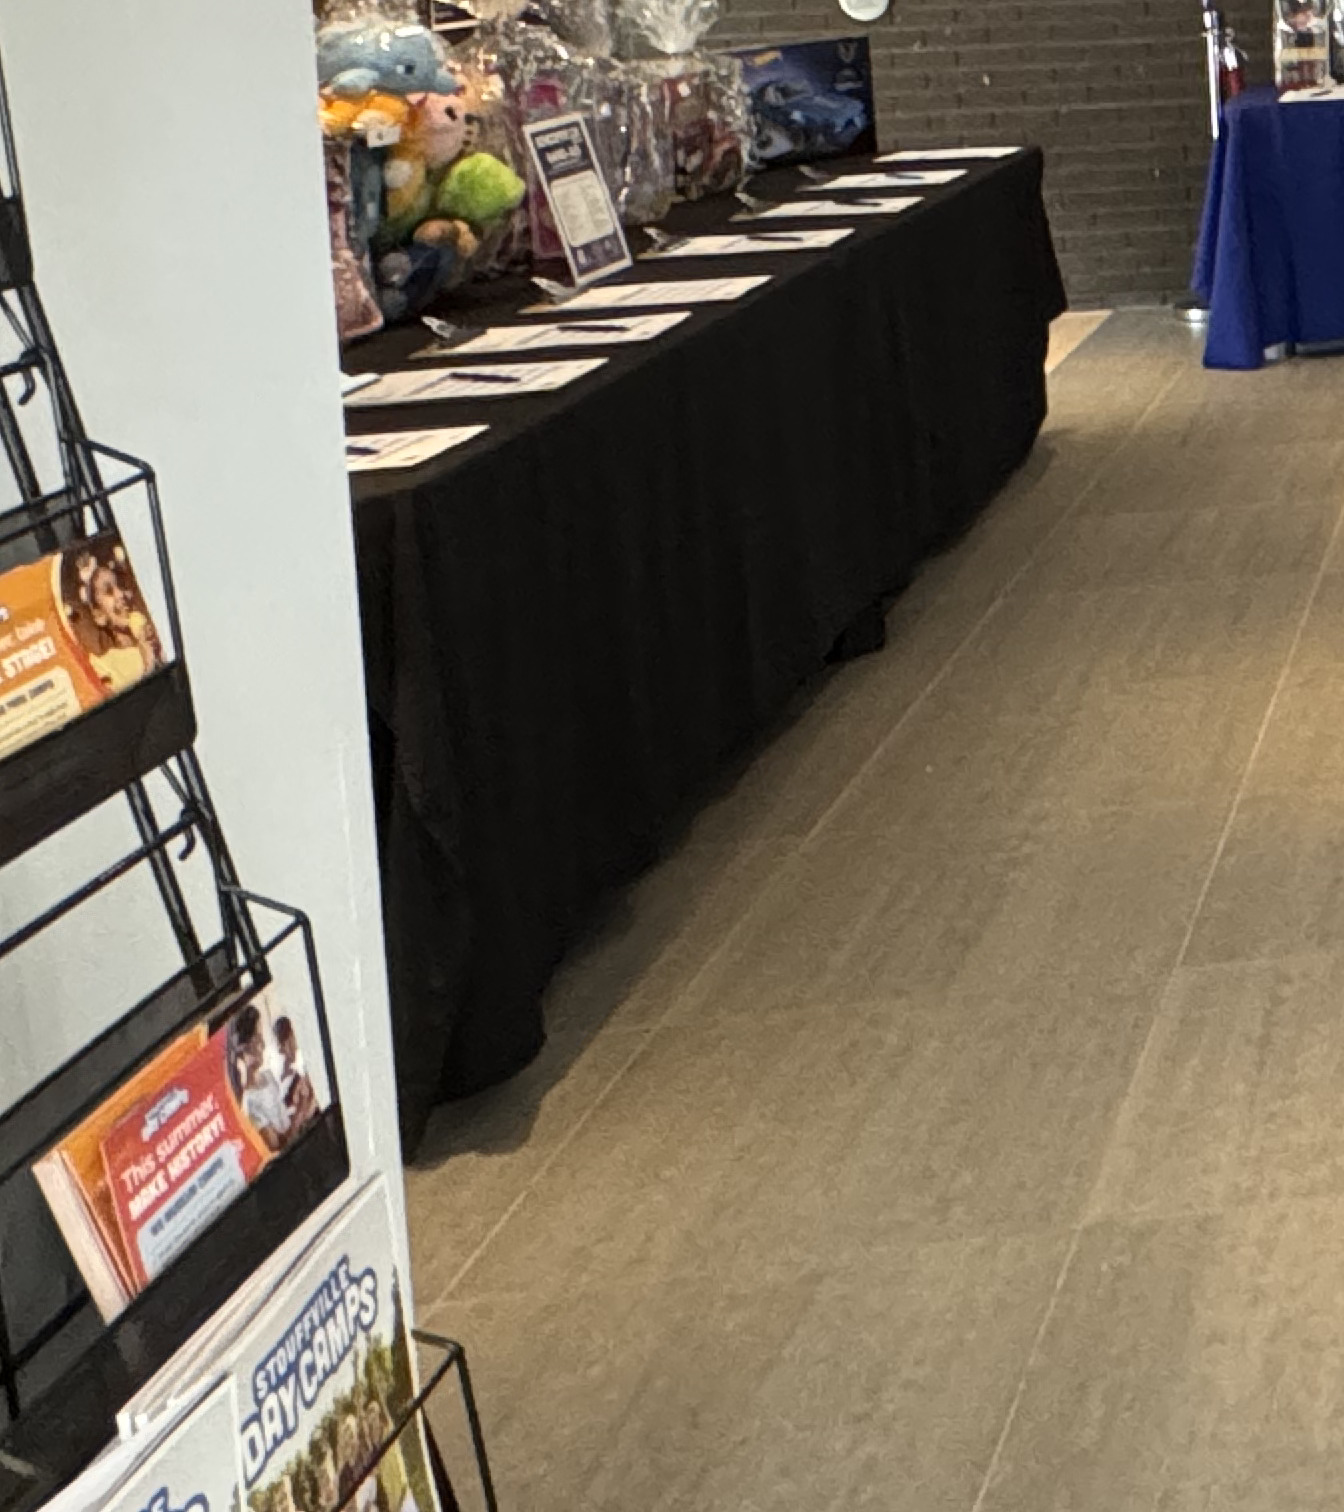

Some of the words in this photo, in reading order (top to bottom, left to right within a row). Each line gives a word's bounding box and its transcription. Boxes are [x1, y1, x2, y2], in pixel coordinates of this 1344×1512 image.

[120, 1152, 156, 1193] This
[242, 1374, 298, 1486] DAY
[299, 1268, 379, 1408] CAMPS
[254, 1259, 350, 1402] STOUFFVILLE
